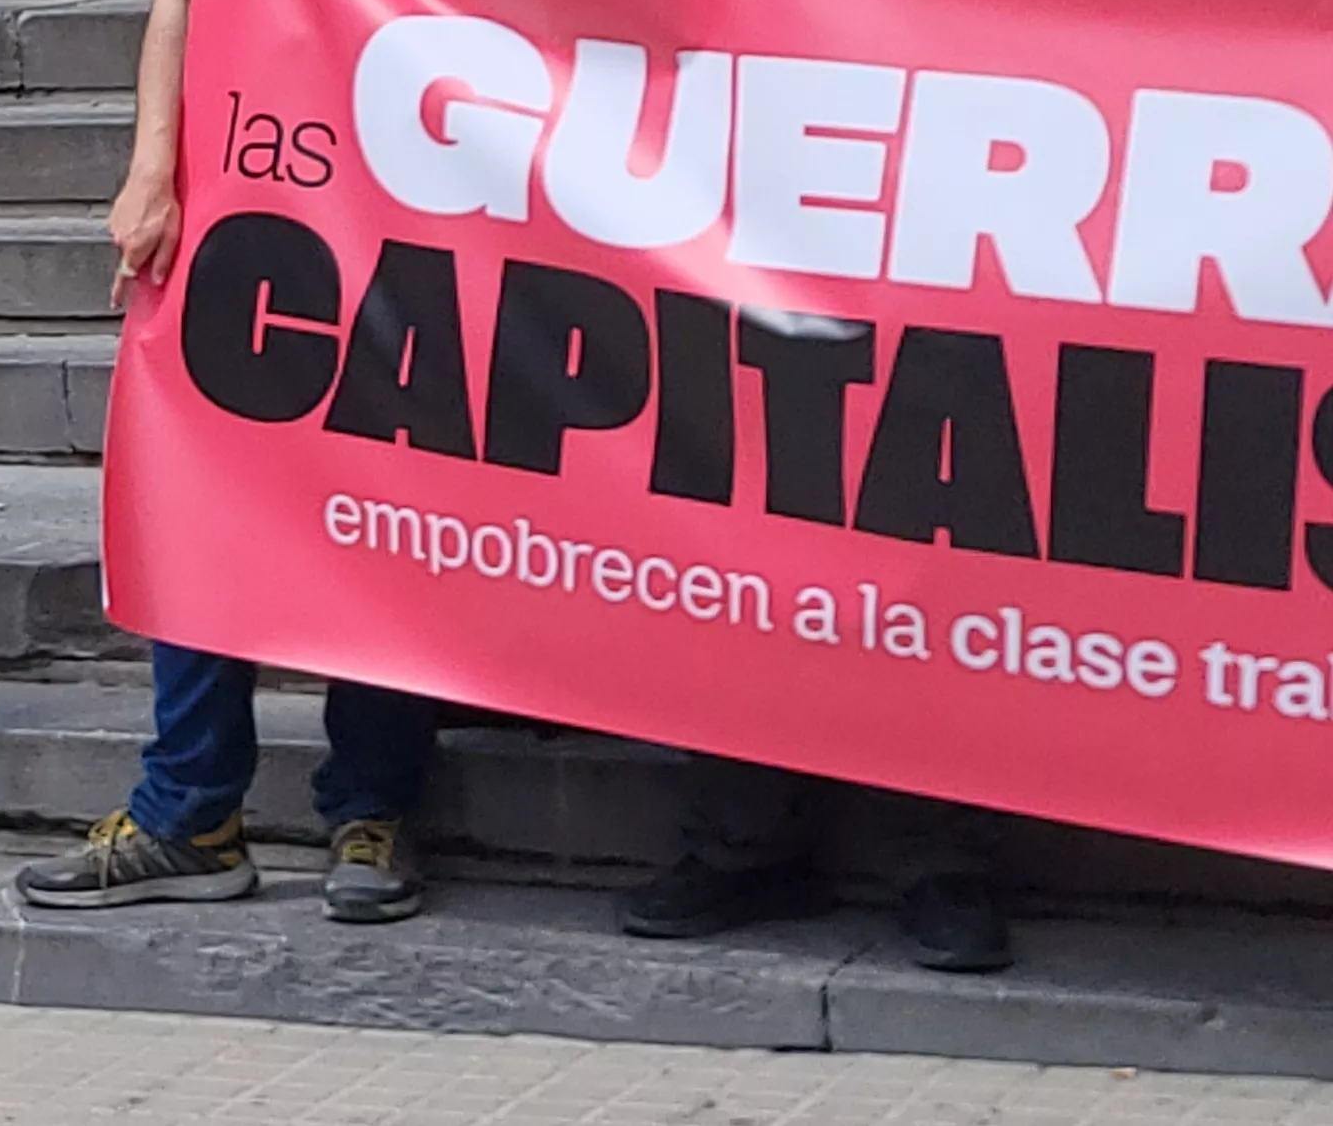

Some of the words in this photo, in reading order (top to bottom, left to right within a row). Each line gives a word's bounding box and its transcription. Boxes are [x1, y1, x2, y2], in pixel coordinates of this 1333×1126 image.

[222, 90, 337, 188] las
[352, 14, 1333, 327] GUERR
[180, 211, 1333, 592] CAPITALI
[324, 492, 774, 632] empobrecen
[792, 585, 840, 644] a
[857, 582, 931, 660] la
[950, 606, 1179, 698] clase
[1197, 640, 1333, 722] tra
